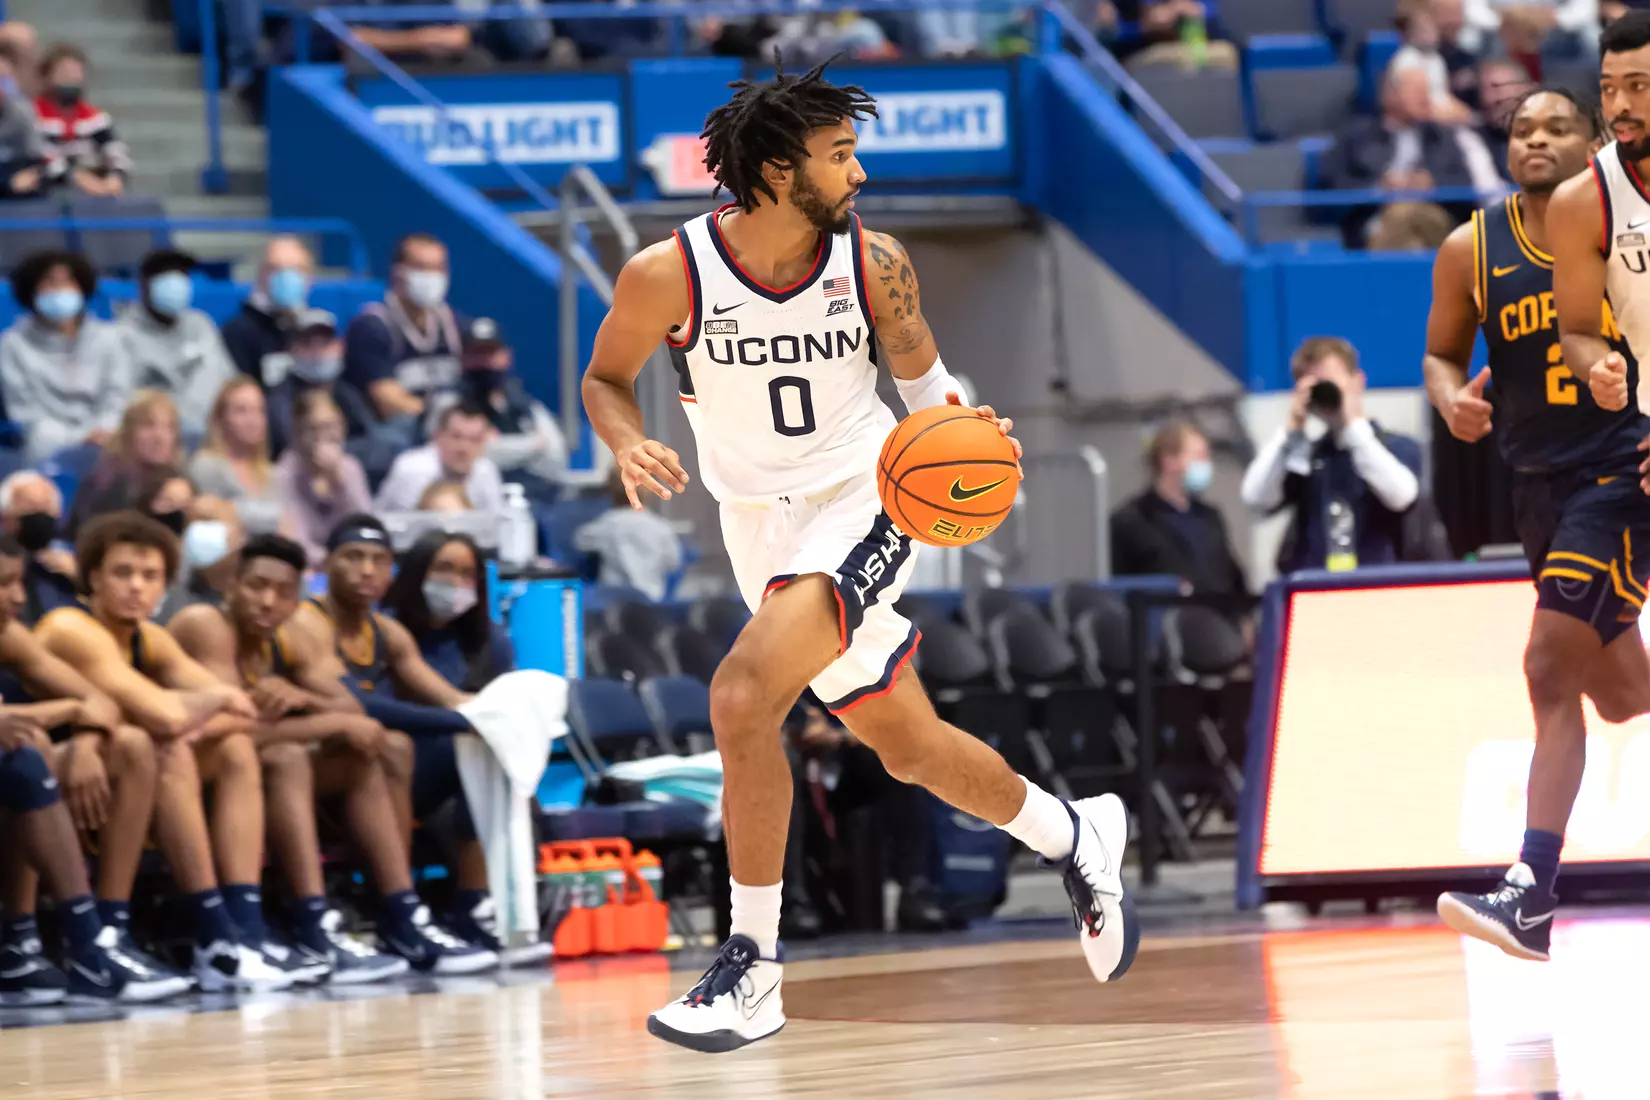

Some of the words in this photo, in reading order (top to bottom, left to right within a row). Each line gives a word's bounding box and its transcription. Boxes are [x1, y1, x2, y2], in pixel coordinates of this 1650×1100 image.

[483, 116, 603, 151] LIGHT
[873, 105, 990, 138] LIGHT
[827, 303, 855, 314] EAST
[829, 298, 849, 307] BIG
[705, 327, 861, 366] UCONN
[1545, 343, 1578, 405] 2
[768, 376, 816, 437] 0
